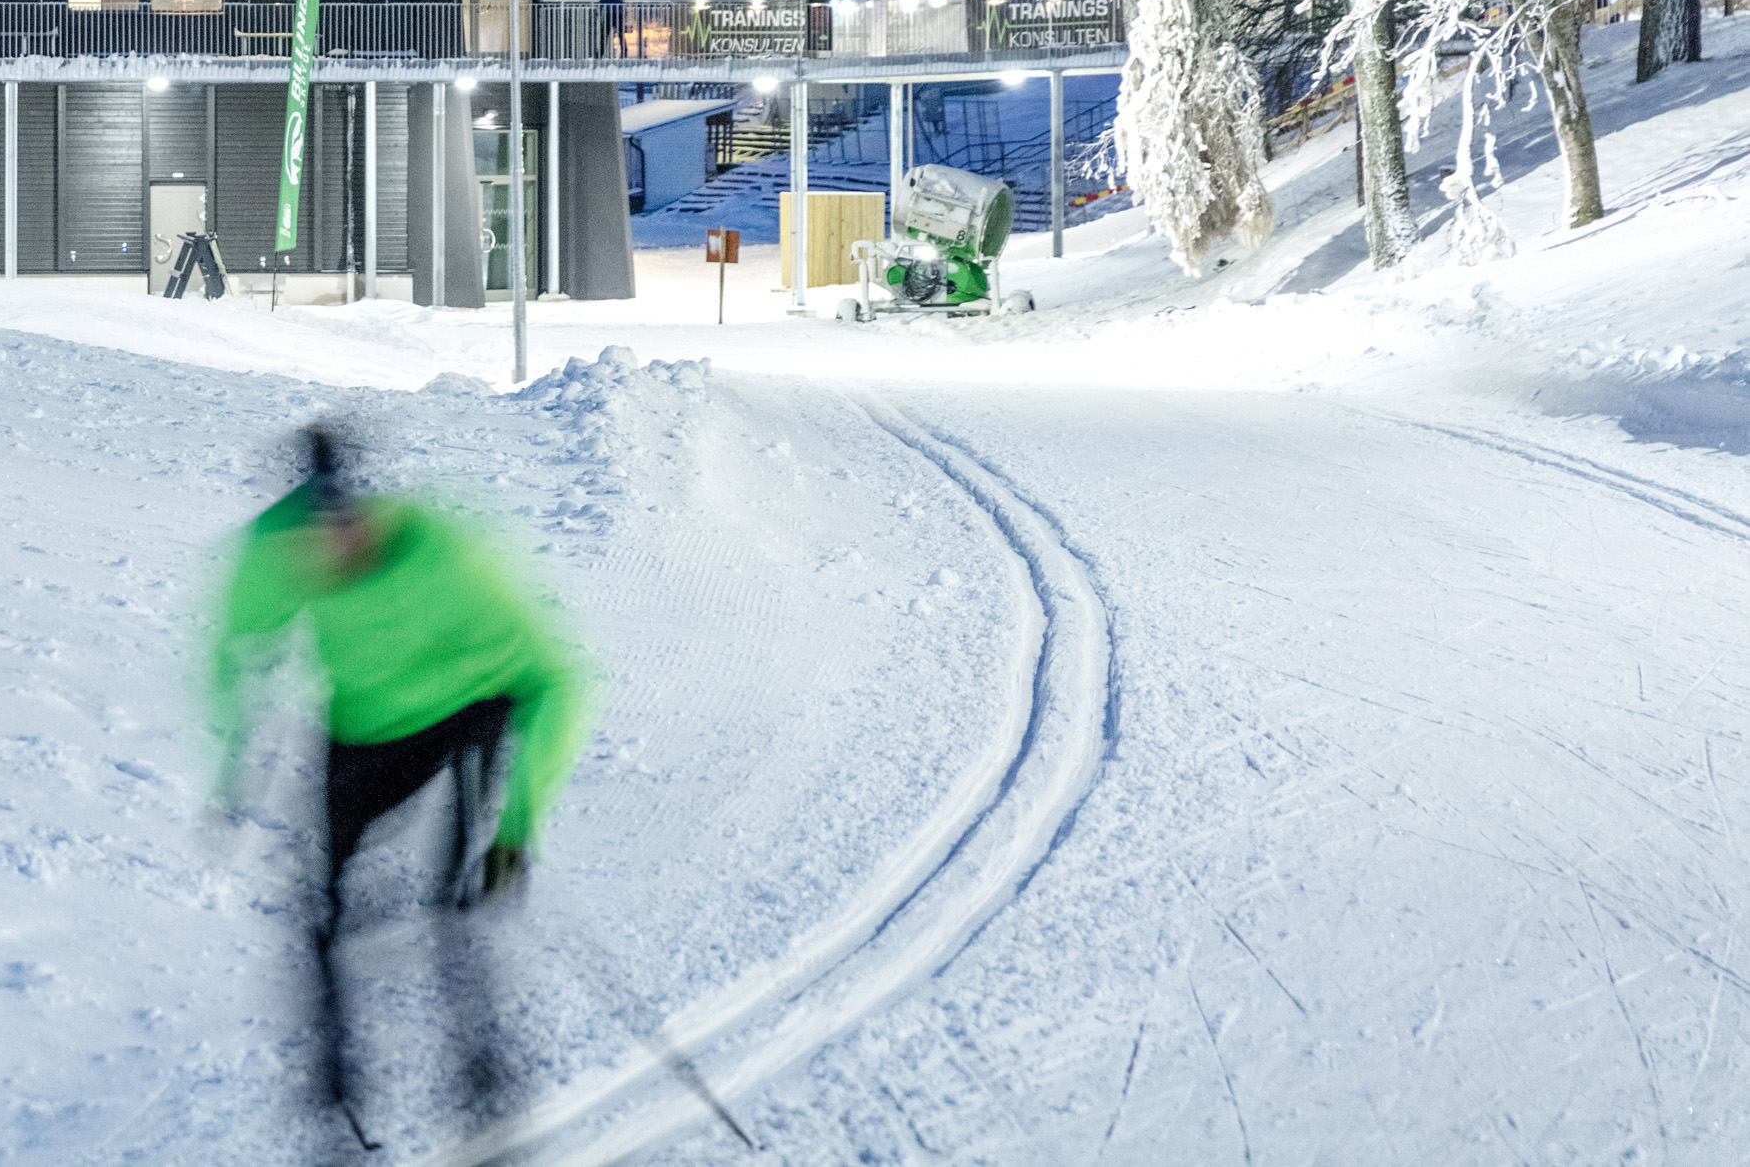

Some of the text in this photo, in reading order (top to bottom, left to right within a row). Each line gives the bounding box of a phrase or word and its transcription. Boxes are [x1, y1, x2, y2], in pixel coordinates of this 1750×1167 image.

[711, 6, 806, 27] TRÄNINGS
[710, 38, 805, 52] KONSULTEN
[1010, 28, 1109, 47] KONSULTEN
[956, 230, 966, 241] 8
